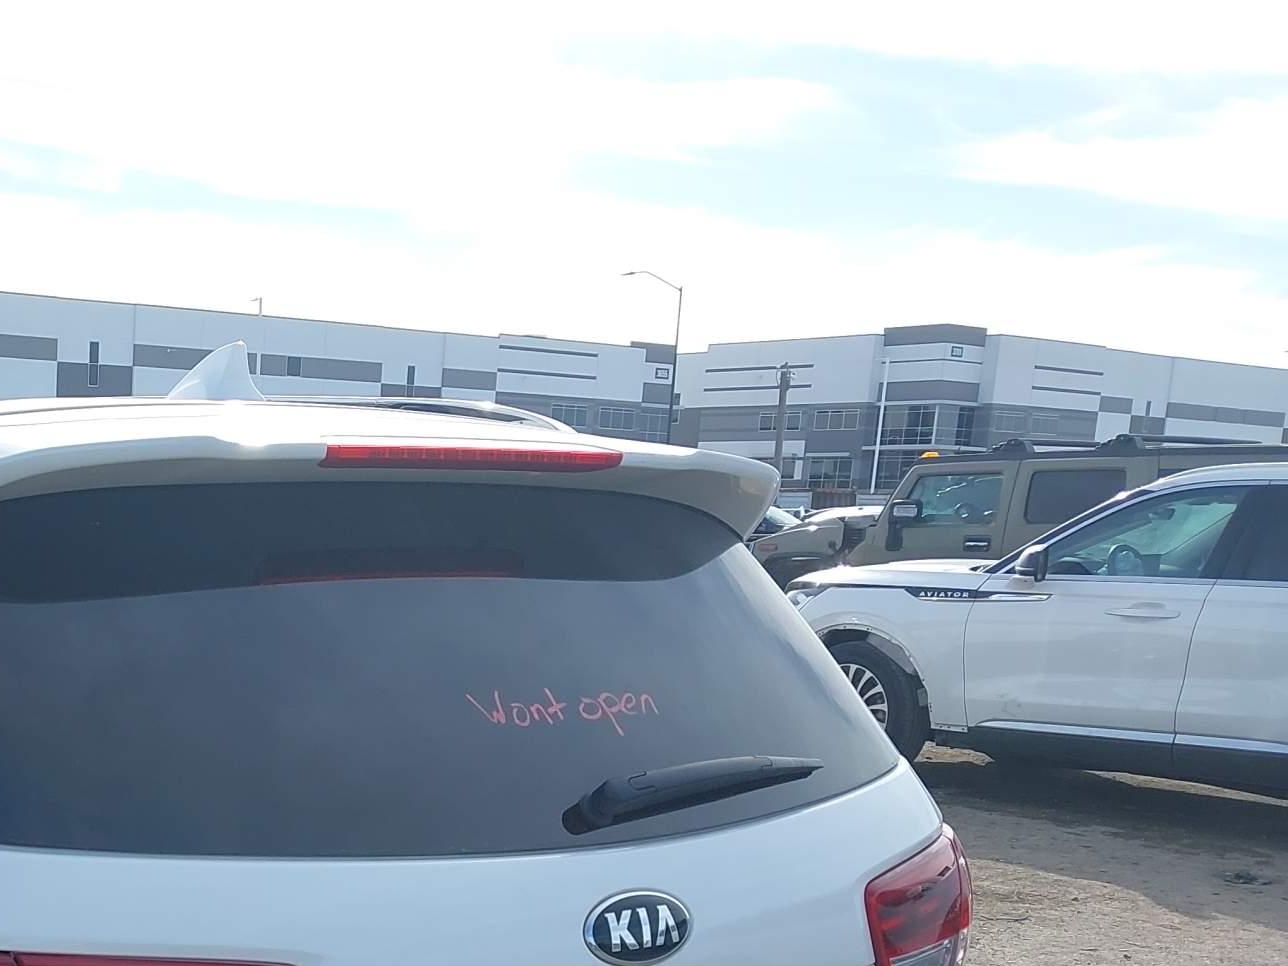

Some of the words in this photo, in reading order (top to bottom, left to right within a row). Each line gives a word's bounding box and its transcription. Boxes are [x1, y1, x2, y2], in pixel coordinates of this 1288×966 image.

[466, 688, 567, 726] Wont
[578, 692, 660, 736] open
[604, 904, 680, 952] KIA
